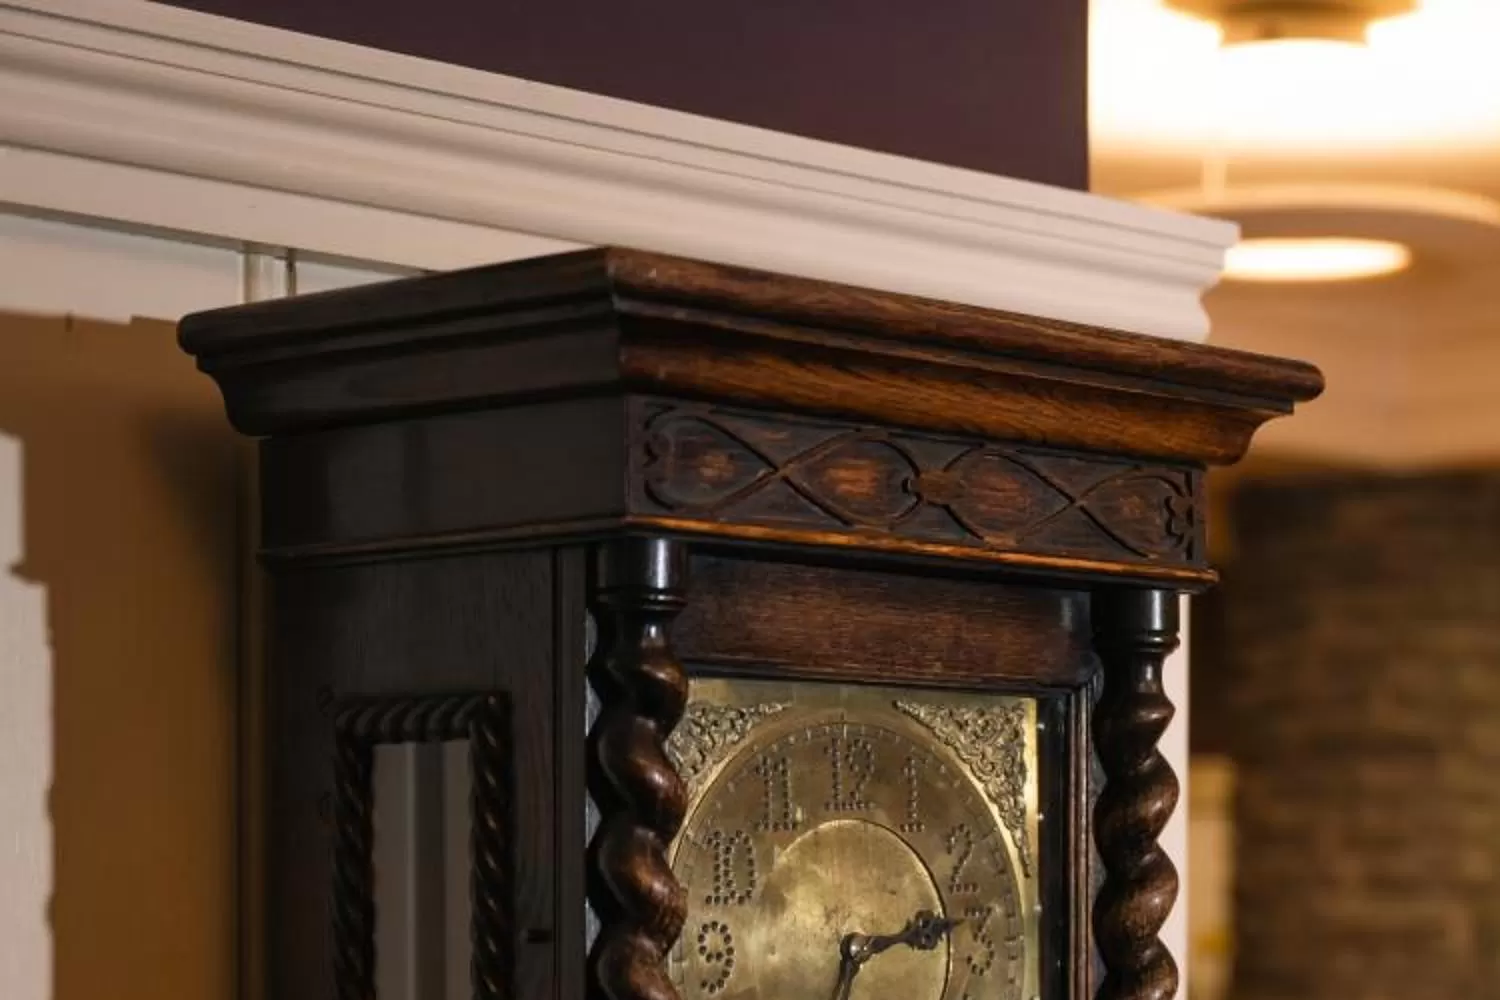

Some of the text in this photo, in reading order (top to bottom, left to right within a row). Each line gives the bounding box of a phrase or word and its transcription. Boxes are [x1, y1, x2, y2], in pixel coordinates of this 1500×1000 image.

[755, 755, 798, 833] 11
[824, 736, 876, 812] 12
[901, 755, 925, 834] 1
[705, 830, 756, 904] 10
[946, 823, 979, 894] 2
[698, 921, 735, 994] 9
[963, 906, 995, 976] 3
